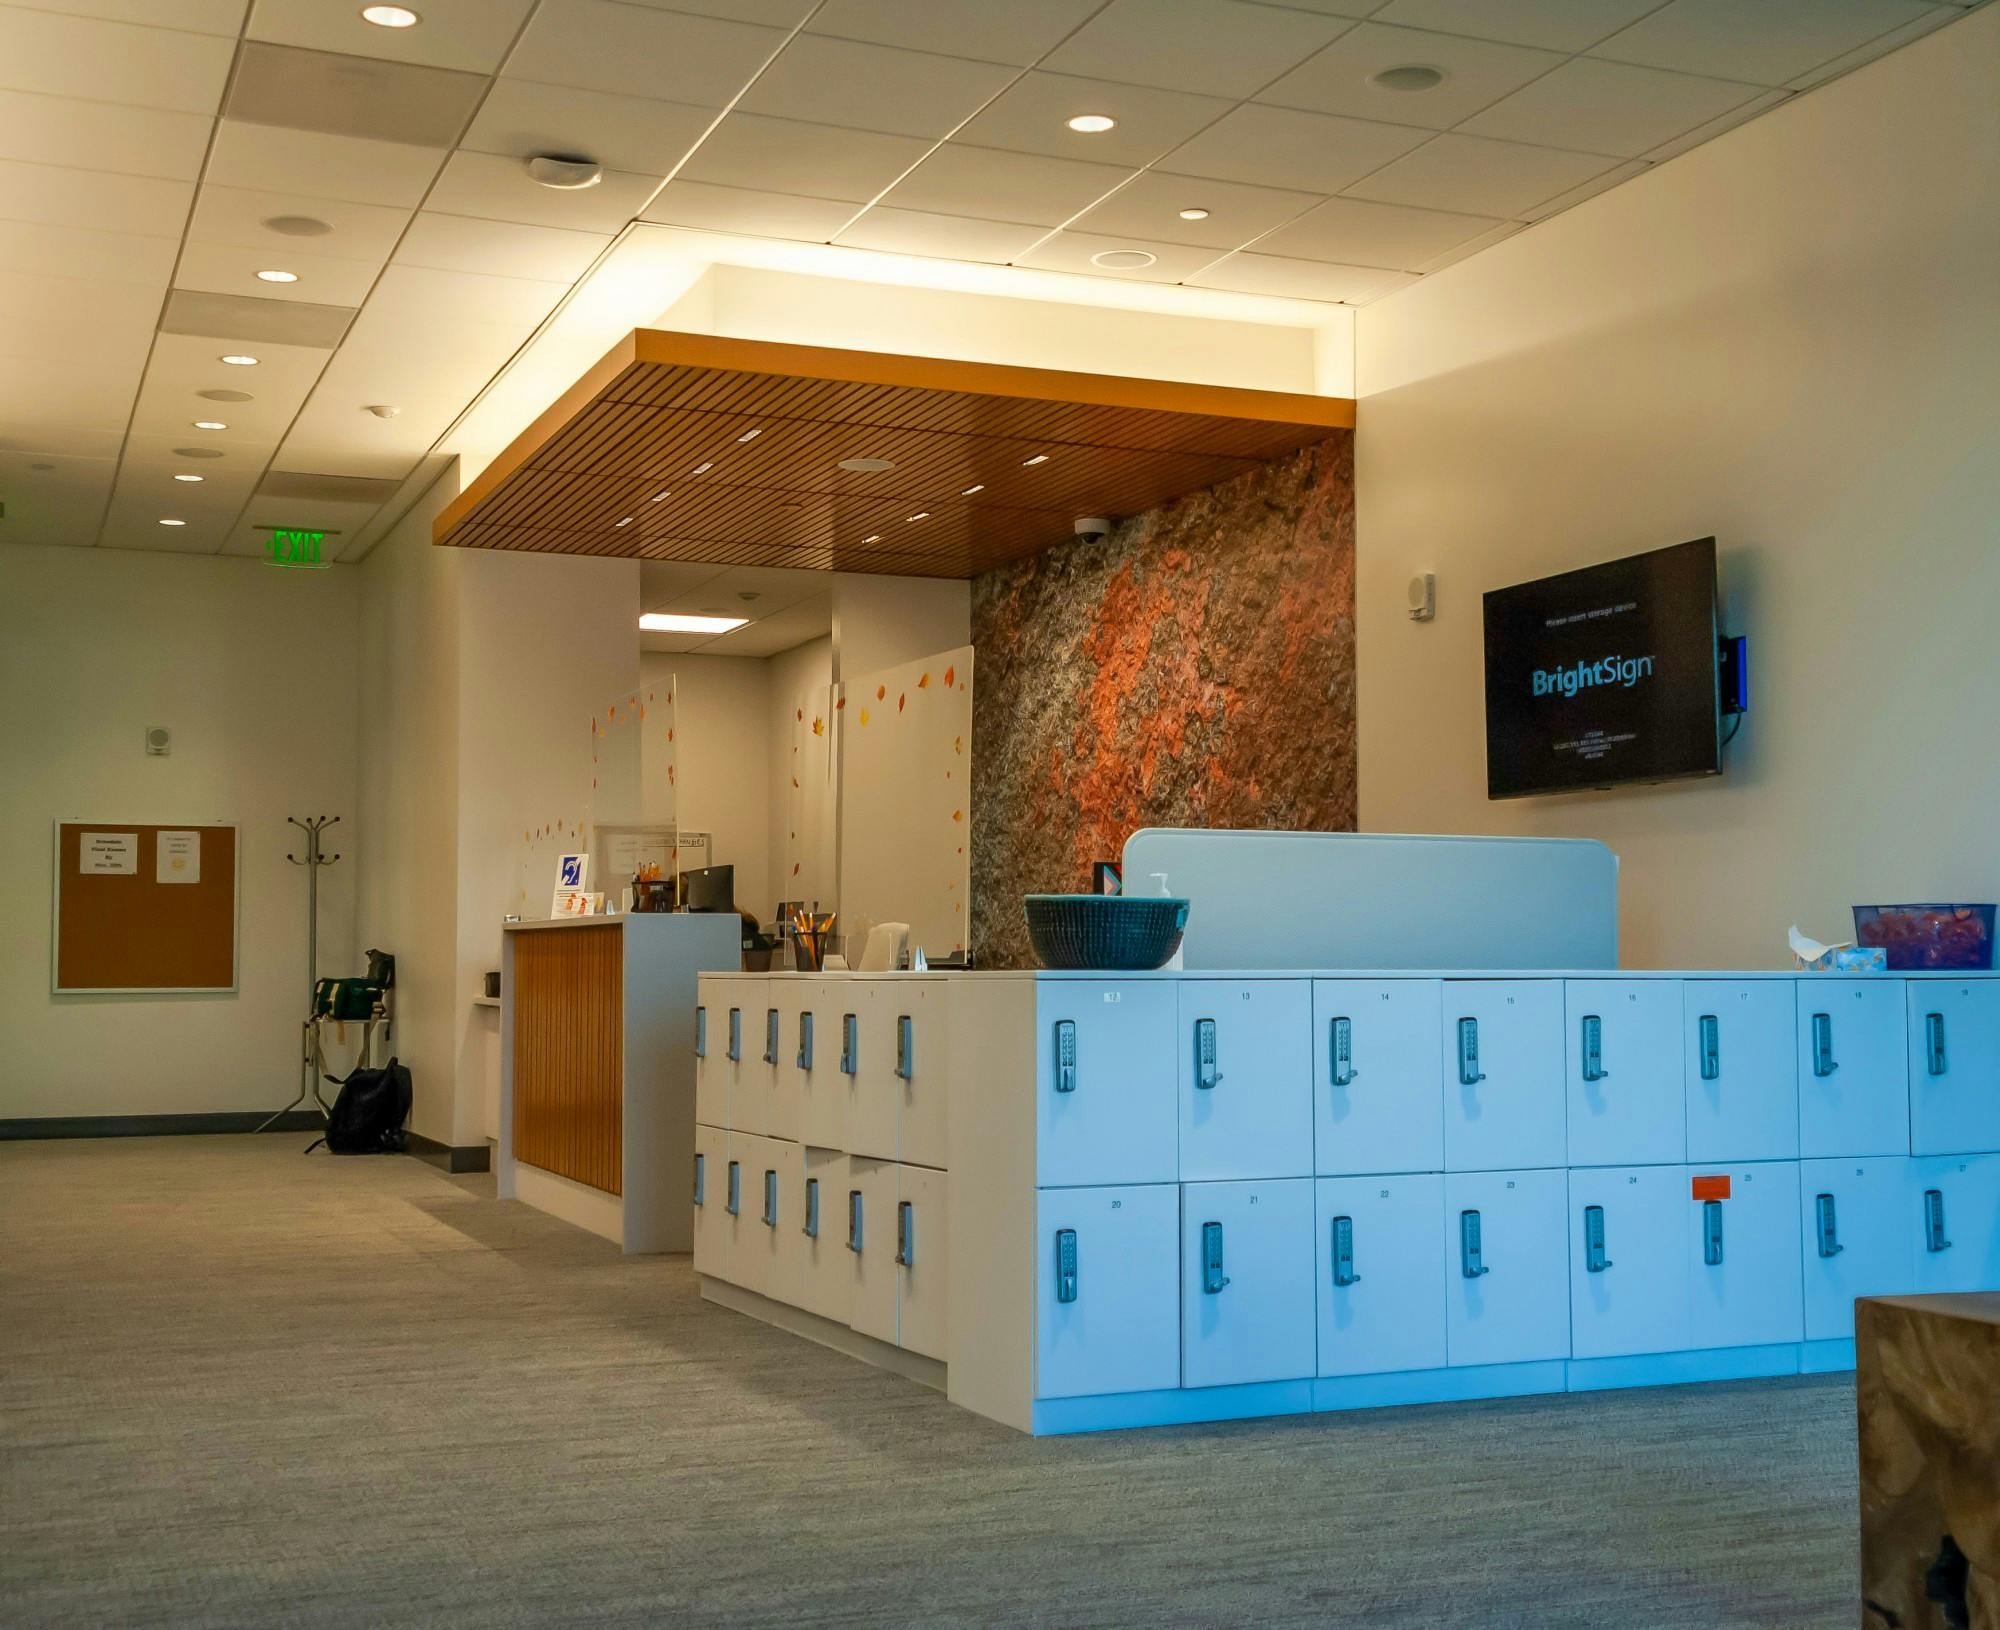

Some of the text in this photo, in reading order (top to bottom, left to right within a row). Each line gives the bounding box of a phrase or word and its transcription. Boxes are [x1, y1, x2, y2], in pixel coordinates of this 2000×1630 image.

[274, 530, 324, 564] EXIT
[1532, 655, 1653, 697] BrightSign
[1243, 992, 1250, 1000] 13
[1250, 1196, 1258, 1204] 21
